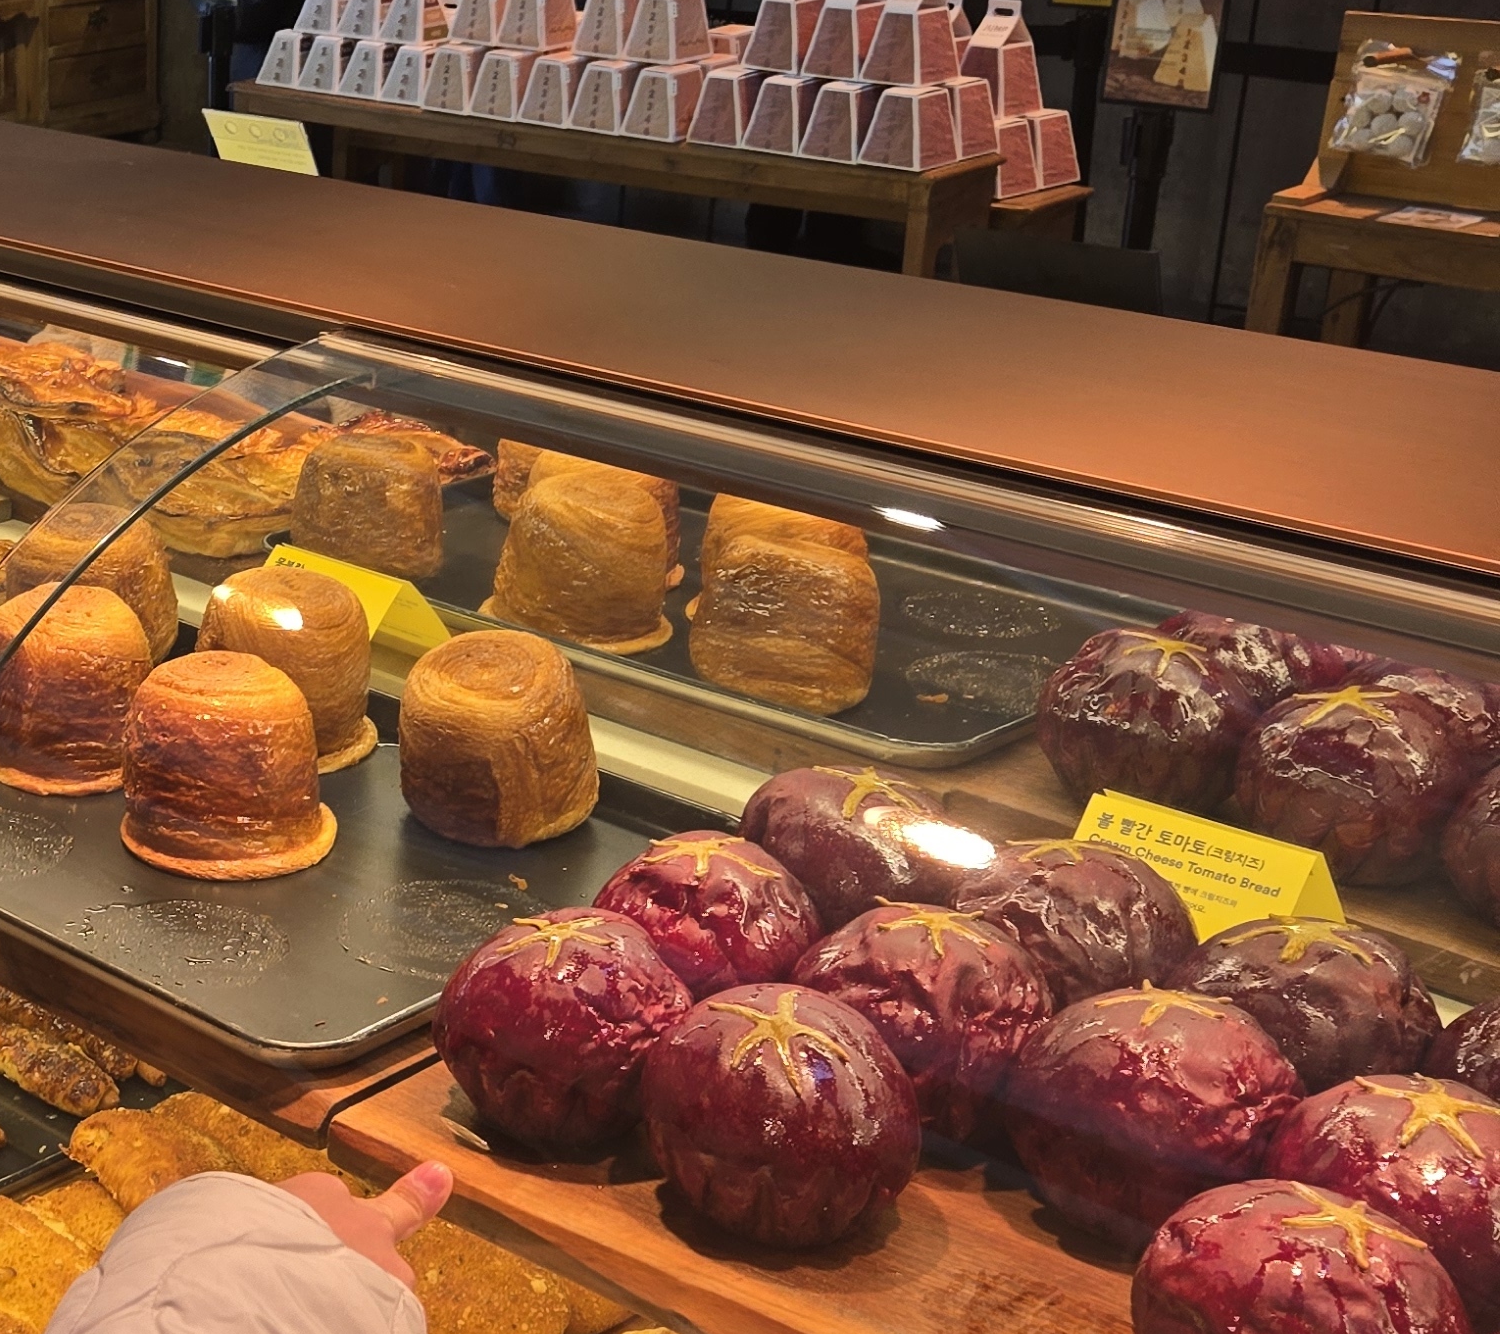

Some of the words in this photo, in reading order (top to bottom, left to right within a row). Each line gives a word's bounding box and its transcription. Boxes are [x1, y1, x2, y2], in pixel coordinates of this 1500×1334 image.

[1096, 812, 1115, 830] 볼
[1119, 817, 1154, 841] 빨간
[1154, 830, 1265, 872] 토마토(크림치즈)
[1134, 846, 1184, 869] Cheese
[1187, 860, 1237, 885] Tomato
[1239, 876, 1282, 898] Bread
